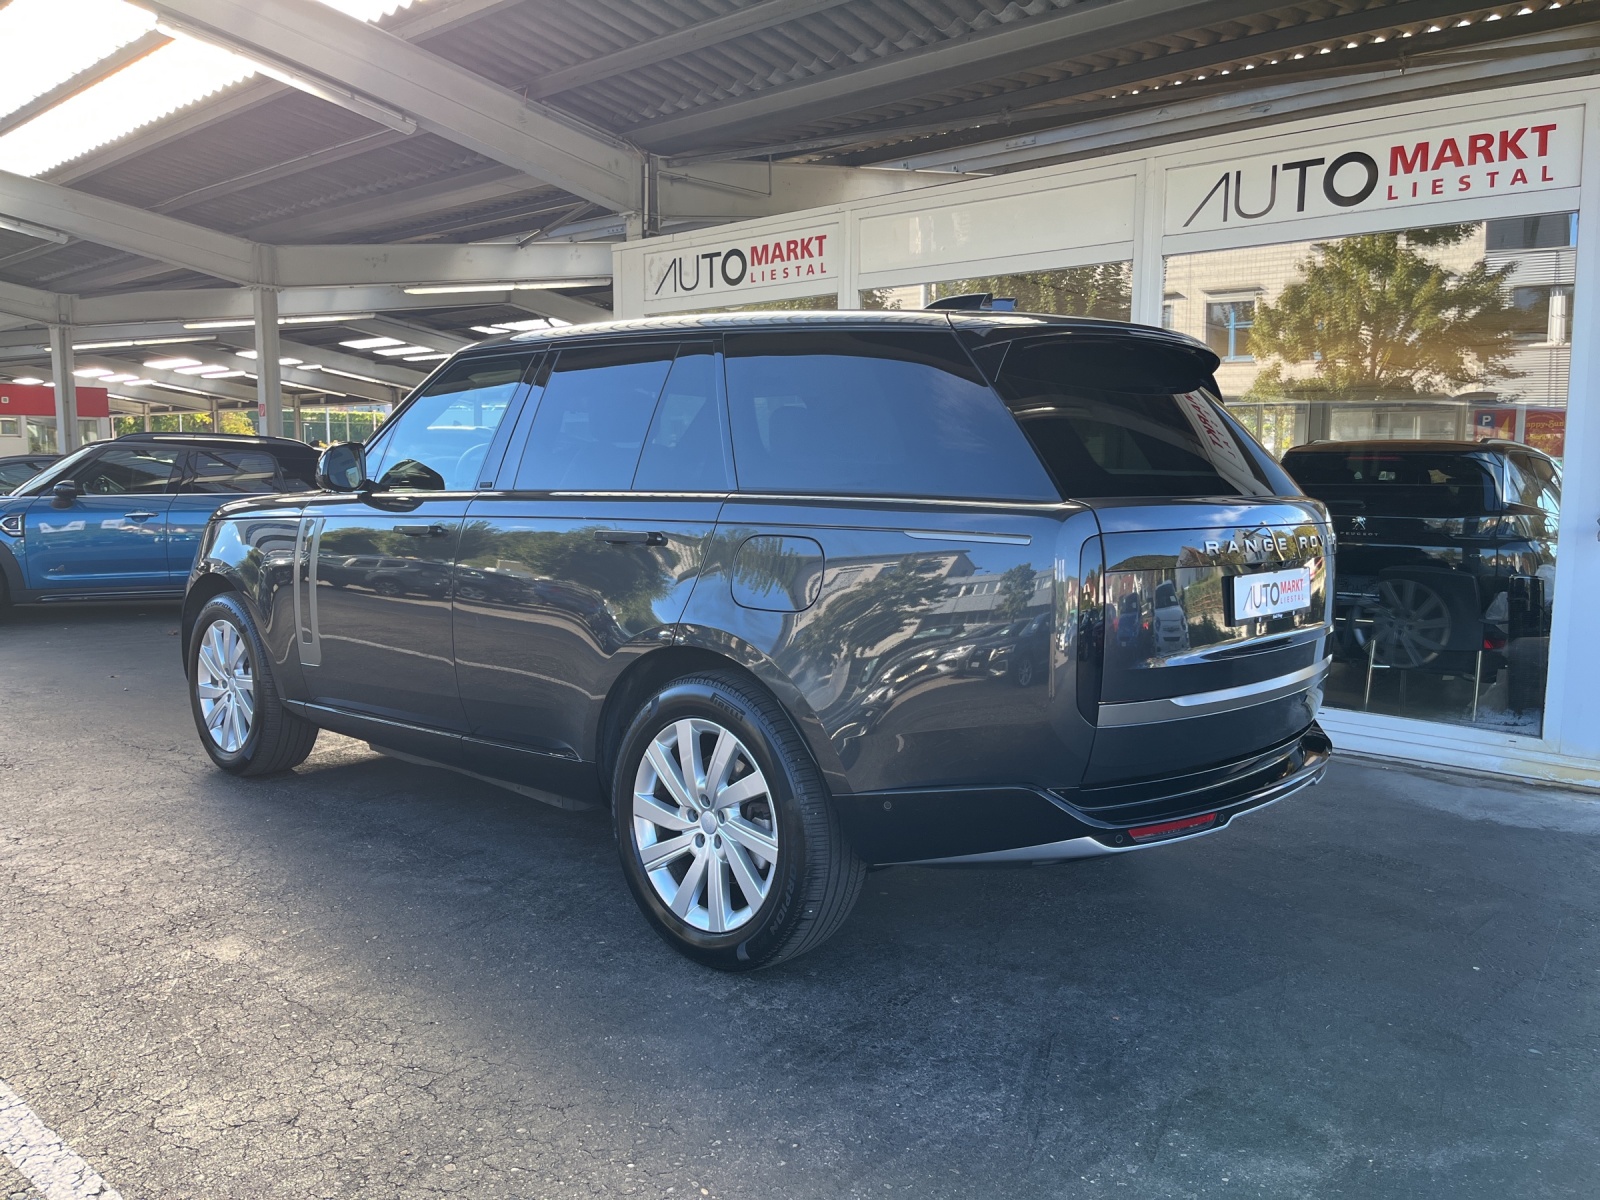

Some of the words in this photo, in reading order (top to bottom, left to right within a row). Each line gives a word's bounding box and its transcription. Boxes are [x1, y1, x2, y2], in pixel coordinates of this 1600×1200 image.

[1182, 151, 1379, 228] AUTO
[1388, 123, 1557, 177] MARKT
[1387, 165, 1555, 201] LIESTAL
[655, 248, 747, 295] AUTO
[750, 234, 827, 267] MARKT
[750, 262, 827, 283] LIESTAL
[1482, 415, 1492, 426] P
[1204, 537, 1287, 555] RANGE
[1299, 532, 1336, 549] ROVER
[1243, 582, 1280, 611] AUTO
[1280, 578, 1304, 594] MARKT
[1280, 594, 1304, 604] LIESTAL
[710, 692, 746, 722] PIRELLI
[770, 841, 797, 936] ORPION
